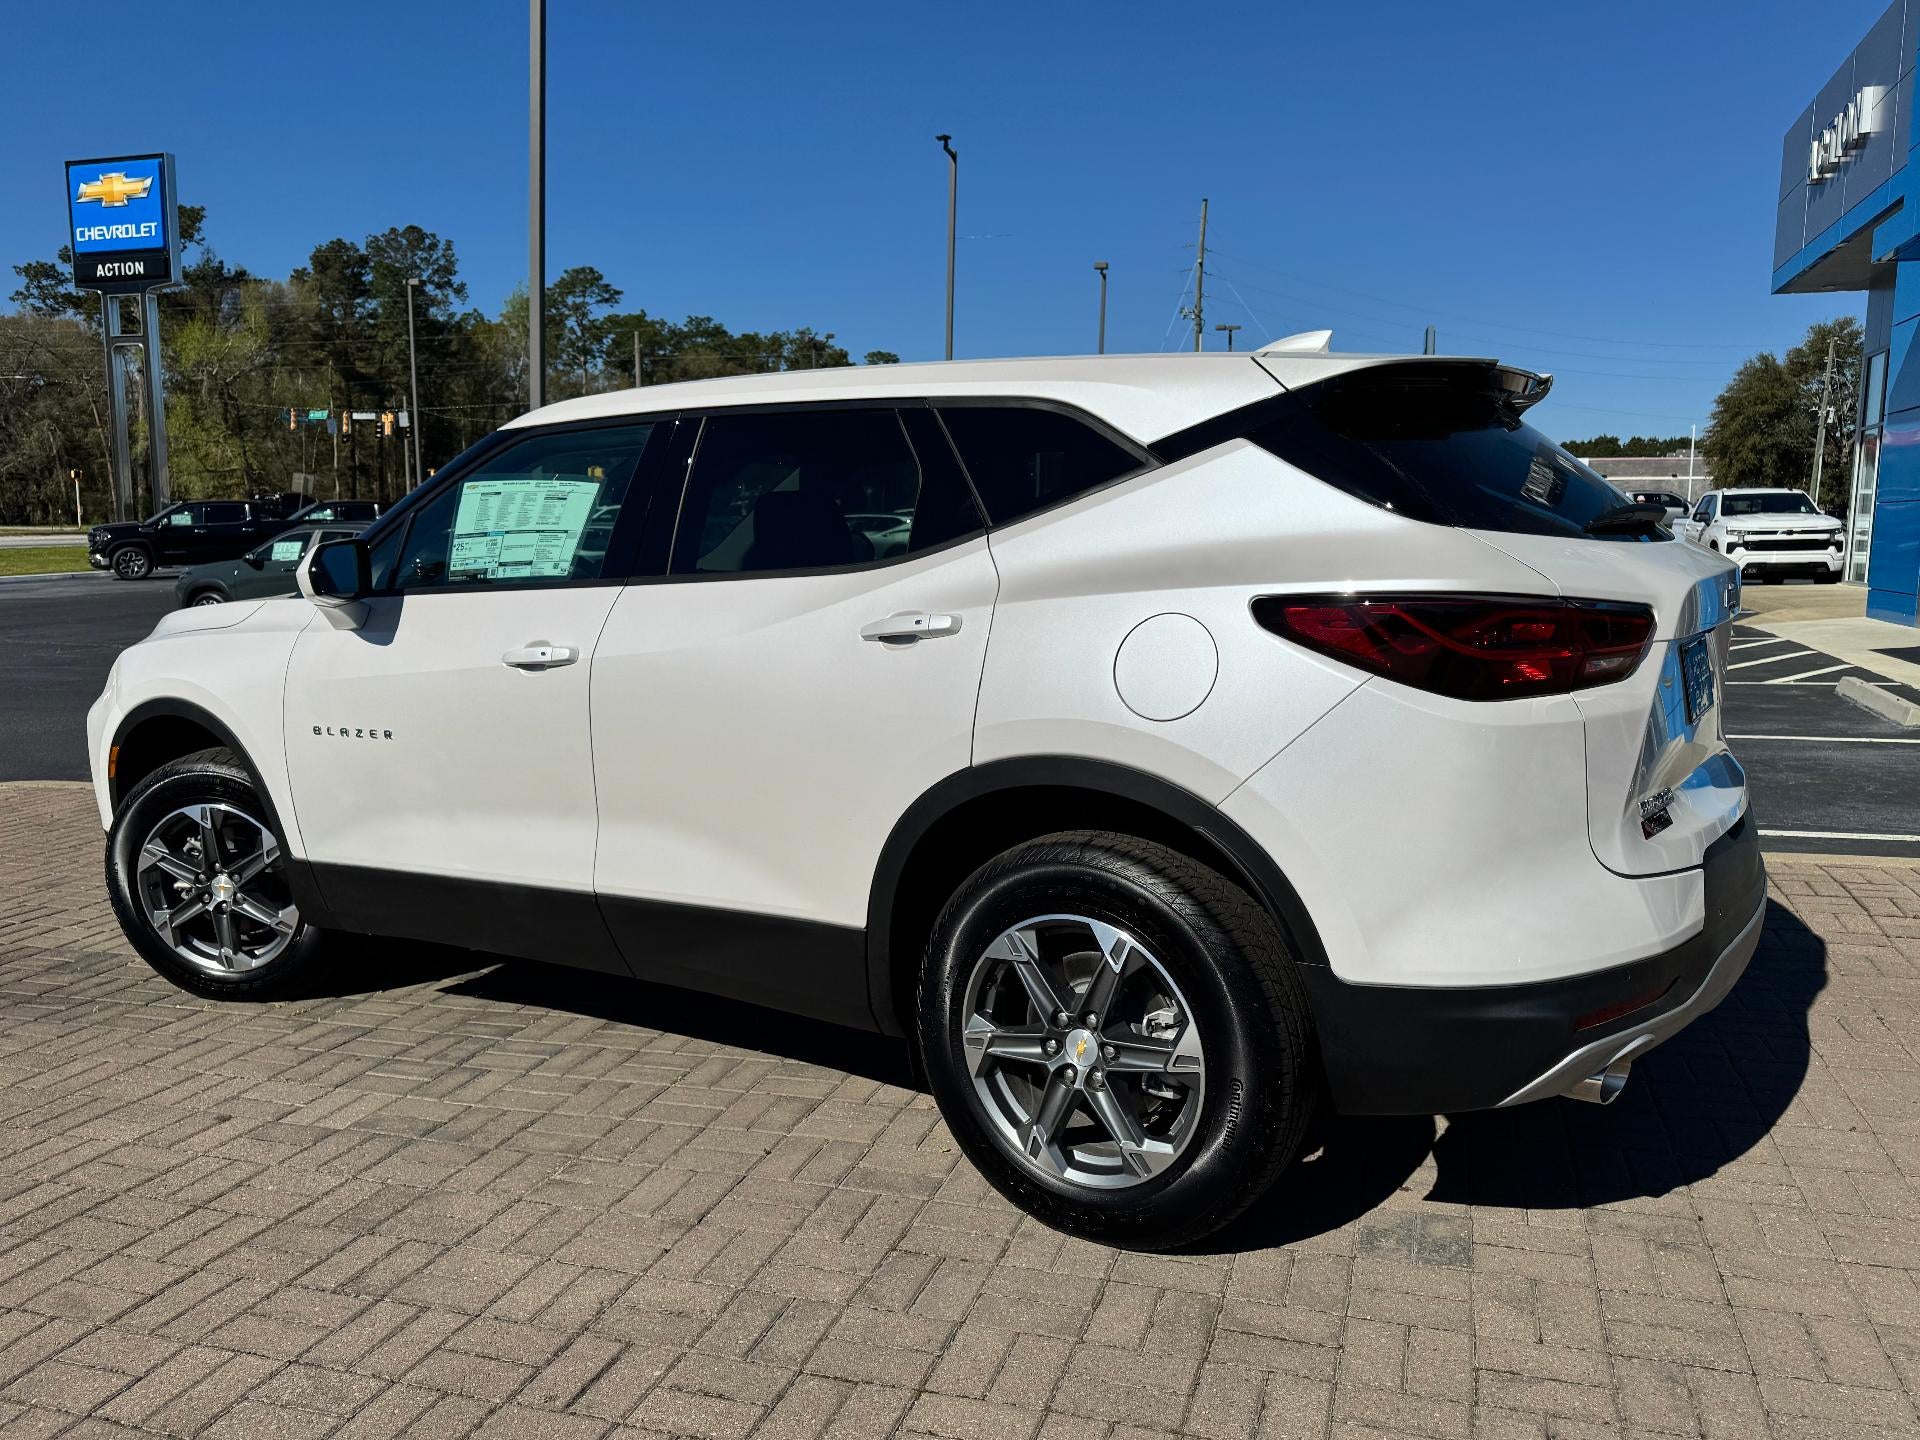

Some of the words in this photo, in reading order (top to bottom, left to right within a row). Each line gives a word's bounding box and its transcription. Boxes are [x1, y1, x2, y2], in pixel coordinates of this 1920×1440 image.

[76, 222, 158, 242] CHEVROLET
[96, 261, 145, 278] ACTION
[312, 725, 394, 741] BLAZER
[1221, 1077, 1244, 1153] Continental
